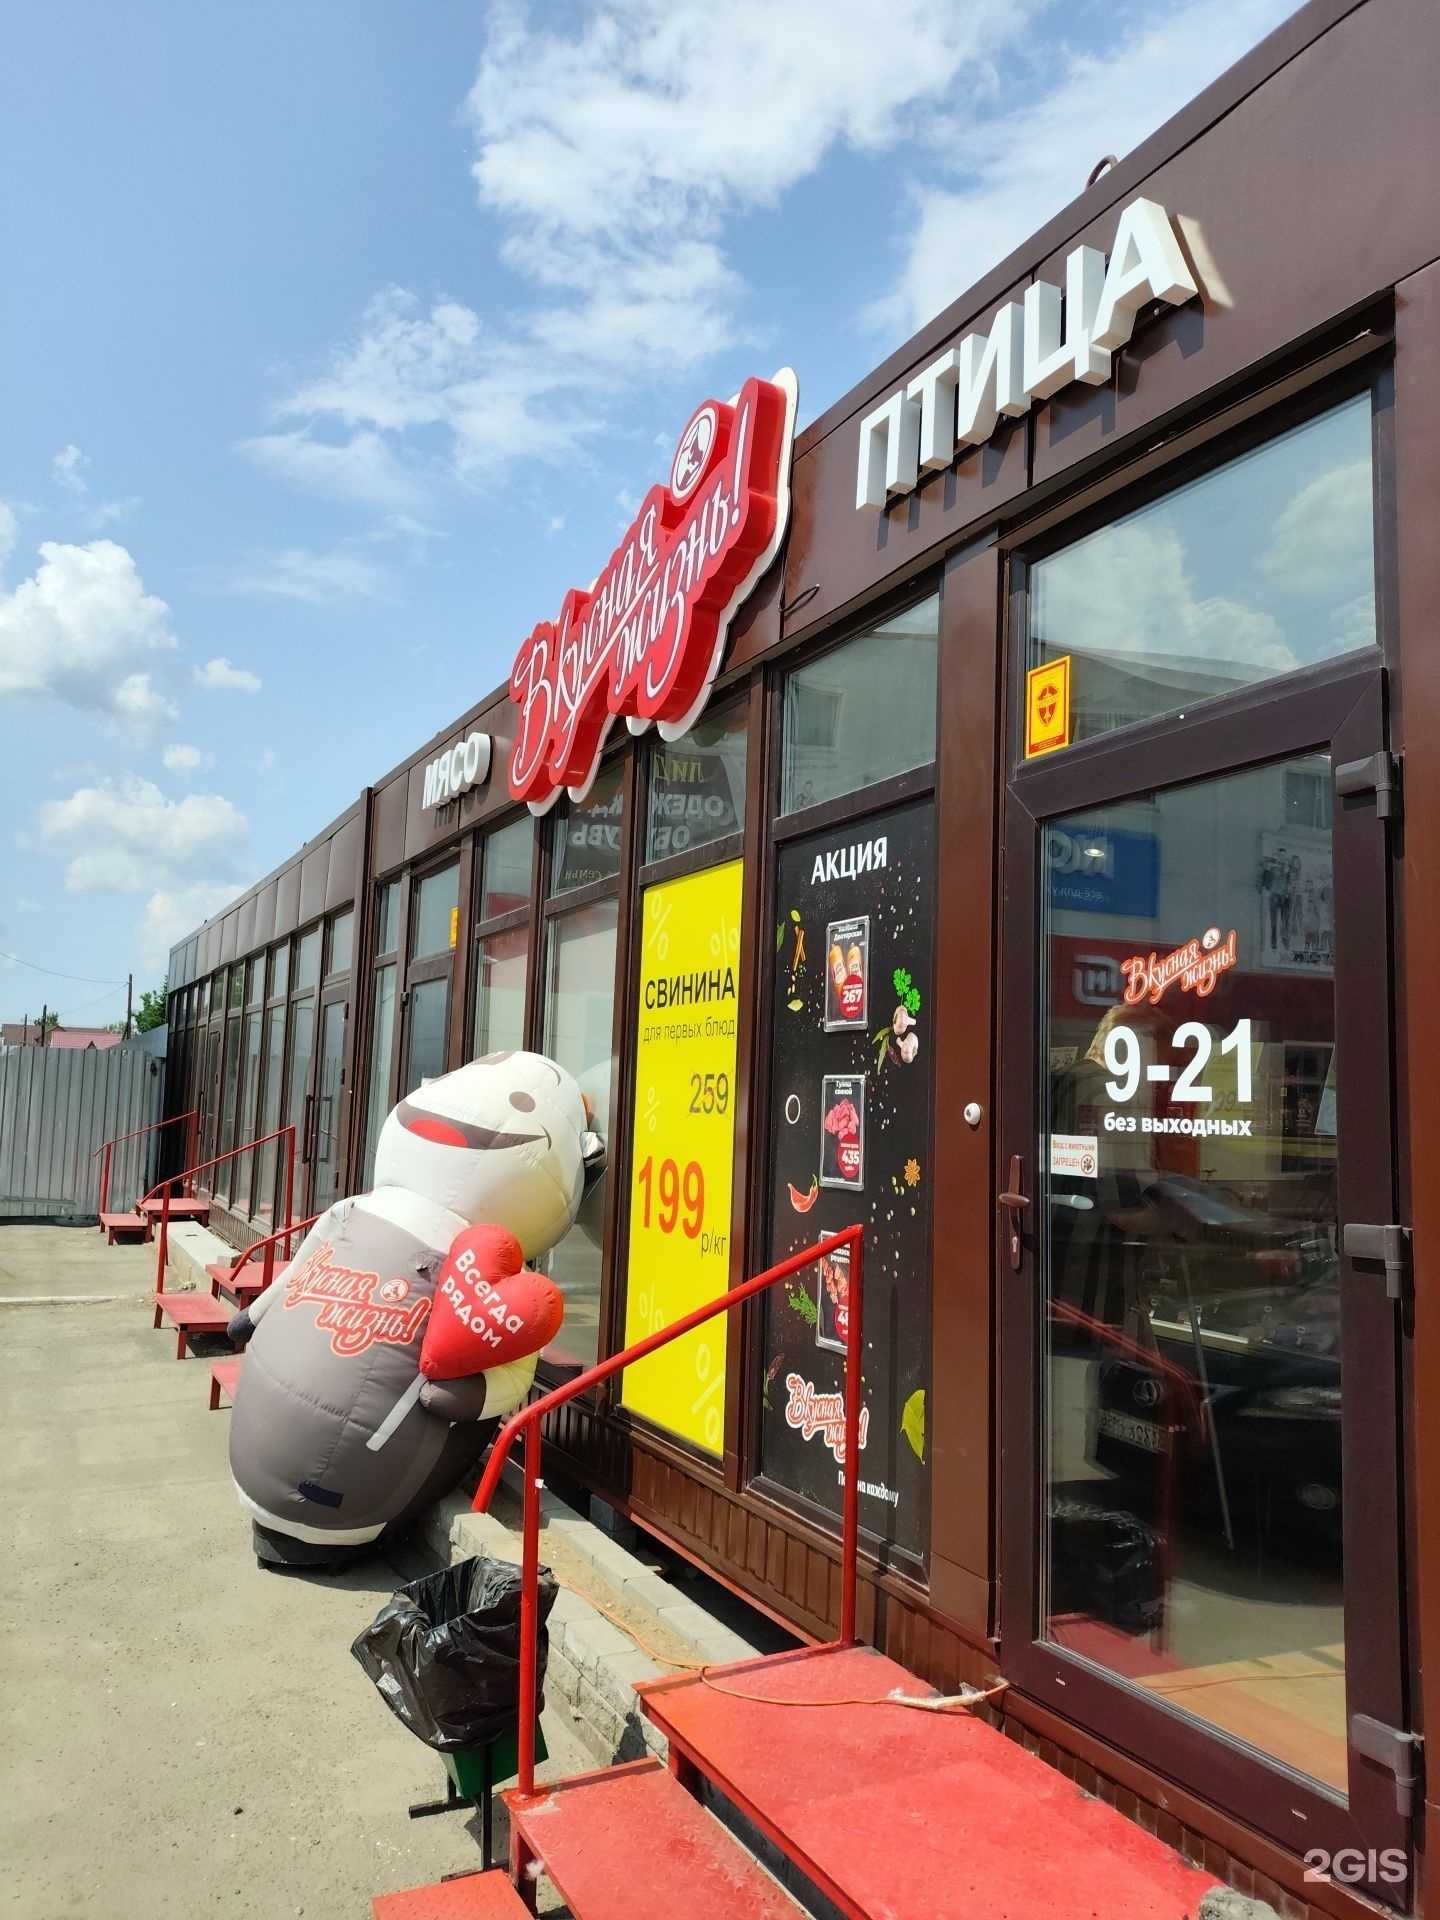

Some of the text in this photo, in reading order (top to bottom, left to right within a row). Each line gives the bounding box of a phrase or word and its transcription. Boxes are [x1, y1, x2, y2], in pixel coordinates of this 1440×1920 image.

[856, 197, 1198, 513] ПТИЦА
[615, 402, 750, 698] жизнь!
[512, 503, 659, 787] Вкусная
[421, 732, 491, 810] МЯСО
[811, 836, 888, 885] АКЦИЯ
[645, 967, 736, 1010] СВИНИНА
[1120, 938, 1201, 1005] Вкусная
[1181, 929, 1237, 998] жизнь!
[842, 988, 862, 1004] 267
[643, 1016, 736, 1048] для первых блюд
[1104, 1018, 1252, 1102] 9-21
[689, 1073, 729, 1115] 259
[1104, 1112, 1252, 1137] без выходных
[638, 1156, 705, 1239] 199
[701, 1227, 726, 1257] р/кг
[316, 1298, 432, 1357] жизнь!
[786, 1374, 845, 1440] Вкусная
[867, 1482, 899, 1508] каждому
